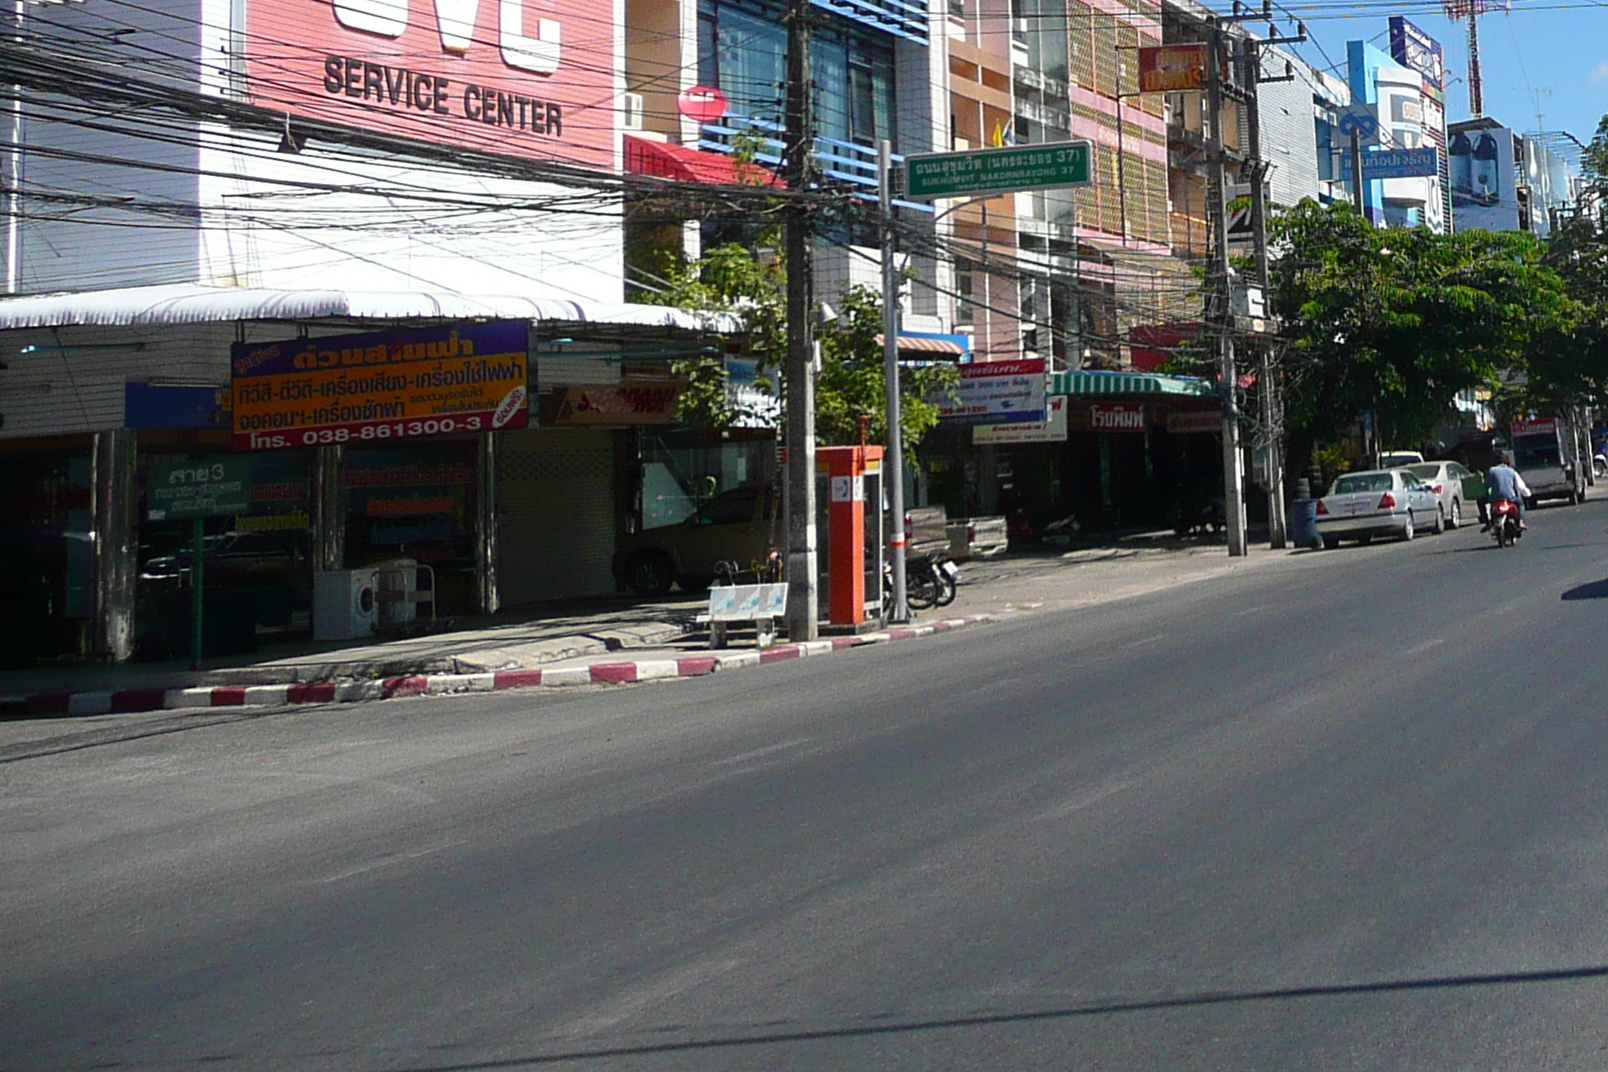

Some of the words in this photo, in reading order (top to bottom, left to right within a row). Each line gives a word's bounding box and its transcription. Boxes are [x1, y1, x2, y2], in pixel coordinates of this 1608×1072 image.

[324, 54, 451, 115] SERVICE
[464, 83, 563, 137] CENTER
[1056, 149, 1080, 164] 37)
[922, 173, 975, 186] SUKHUMVIT
[1061, 166, 1075, 175] 37
[1090, 404, 1144, 428] โรงพิมพ์
[251, 432, 292, 450] โทร.
[303, 416, 483, 445] 038-861300-3
